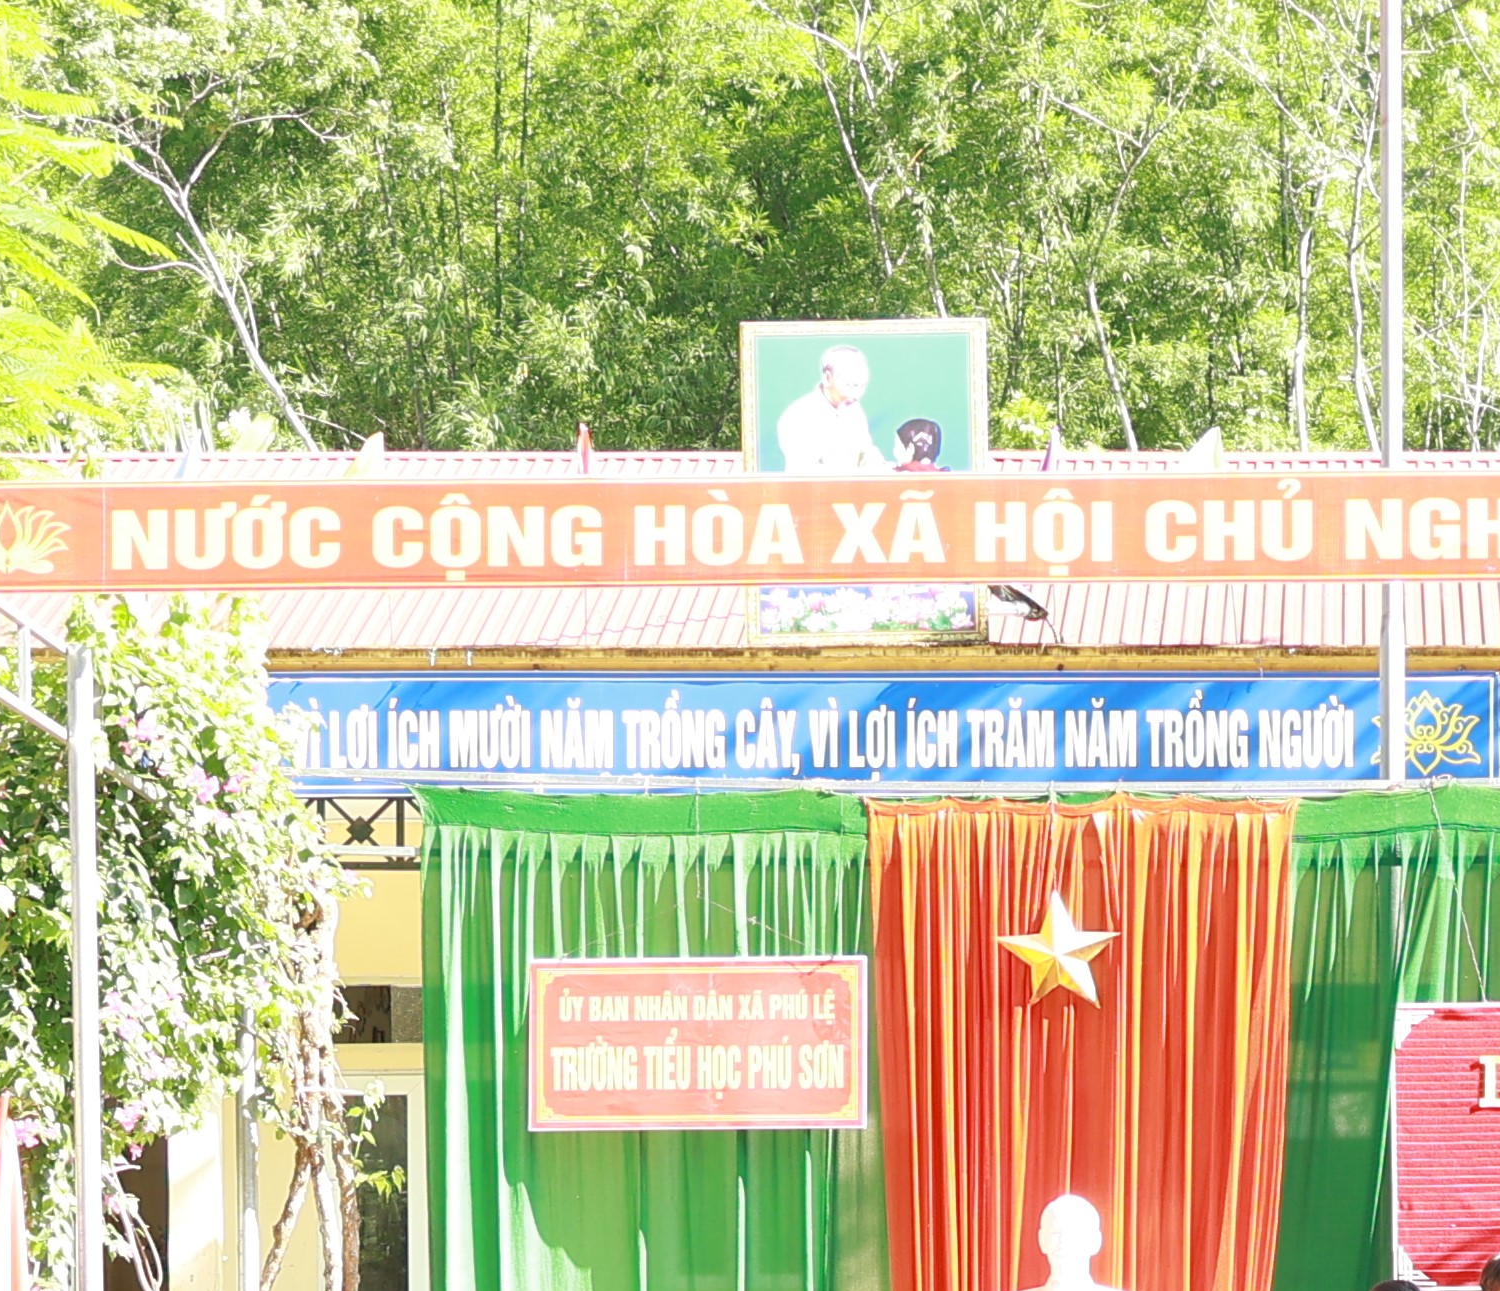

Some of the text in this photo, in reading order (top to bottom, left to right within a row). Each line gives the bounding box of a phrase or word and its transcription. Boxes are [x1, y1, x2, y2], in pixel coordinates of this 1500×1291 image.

[111, 494, 341, 571] NƯỚC
[371, 493, 604, 581] CỘNG
[634, 488, 804, 567] HÒA
[832, 488, 946, 565] XÃ
[975, 487, 1113, 577] HỘI
[1145, 478, 1313, 563] CHỦ
[387, 697, 440, 769] ÍCH
[448, 694, 531, 769] MƯỜI
[540, 698, 614, 769] NĂM
[622, 689, 725, 770] TRỒNG
[735, 698, 800, 776] CÂY,
[808, 698, 838, 769] VÌ
[848, 704, 896, 781] LỢI
[906, 697, 958, 769] ÍCH
[967, 697, 1055, 769] TRĂM
[1064, 697, 1137, 769] NĂM
[1146, 689, 1249, 769] TRỒNG
[1258, 694, 1355, 769] NGƯỜI
[559, 987, 836, 1025] ỦY BAN NHÂN DÂN XÃ PHÚ LỆ
[550, 1027, 845, 1100] TRƯỜNG TIỂU HỌC PHÚ SƠN
